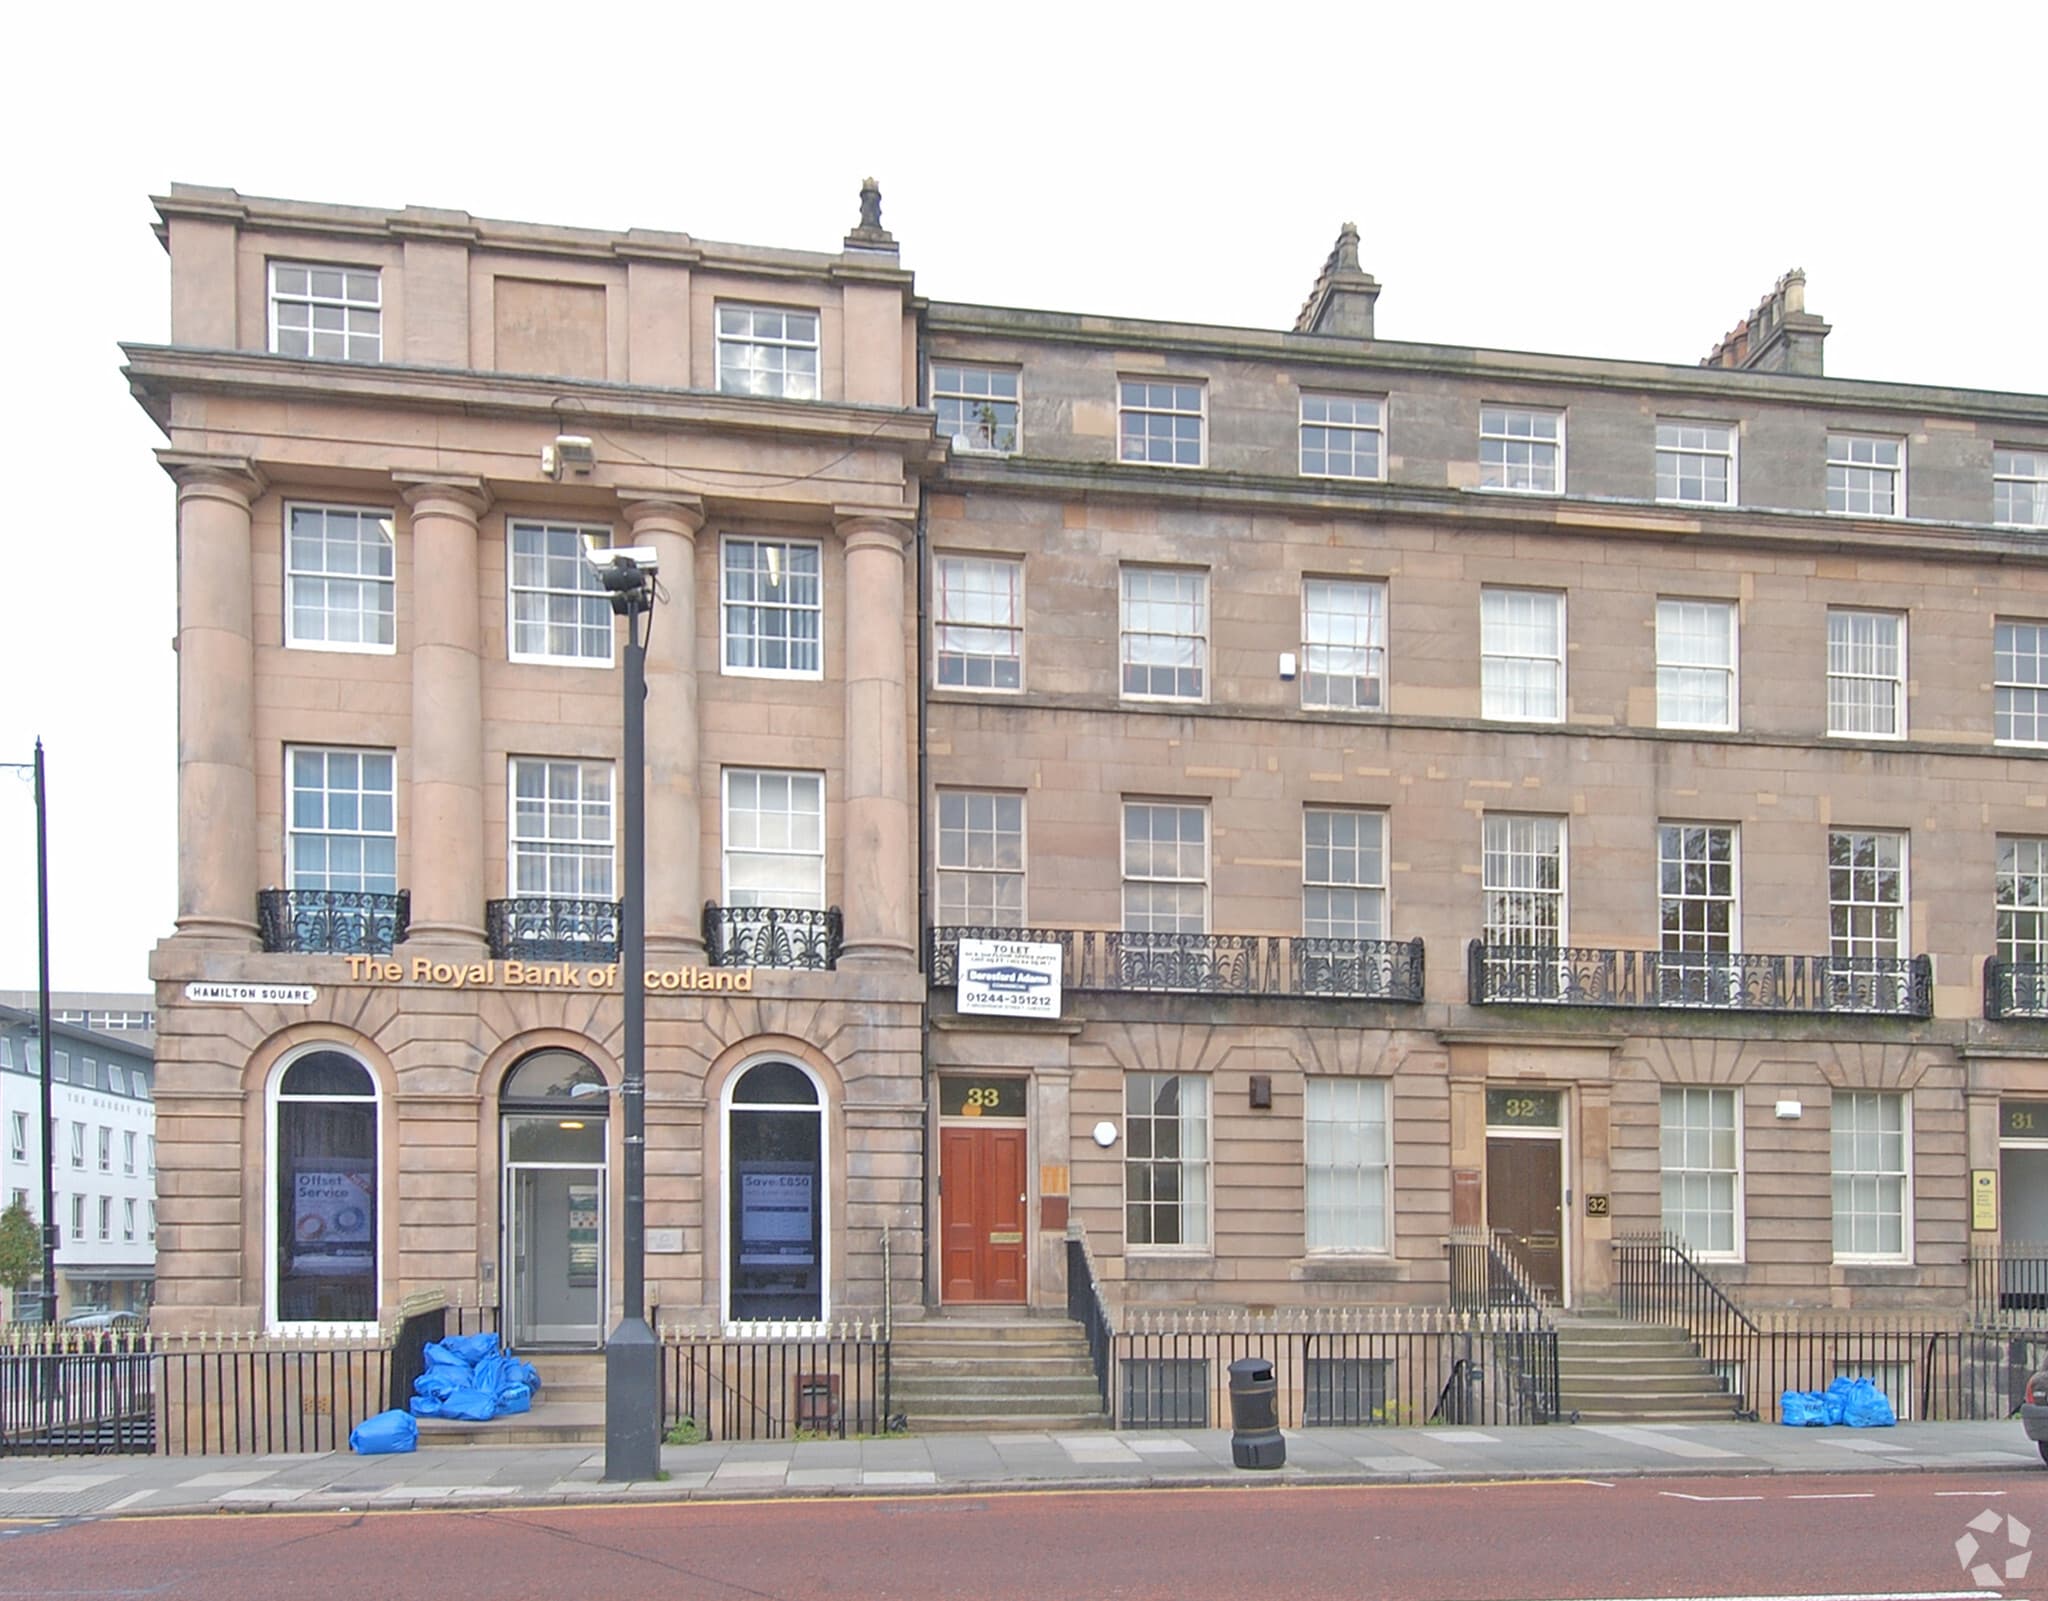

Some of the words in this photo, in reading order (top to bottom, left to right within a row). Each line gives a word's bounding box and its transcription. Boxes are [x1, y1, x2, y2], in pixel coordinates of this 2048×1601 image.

[993, 944, 1008, 954] TO
[1010, 945, 1030, 954] LET
[345, 955, 403, 982] The
[412, 956, 494, 988] Royal
[503, 960, 580, 986] Bank
[586, 963, 617, 987] of
[643, 965, 753, 991] cotland
[193, 986, 256, 998] HAMILTON
[261, 989, 310, 1000] SQUARE
[966, 992, 1051, 1006] 01244-351212
[967, 1087, 999, 1107] 33
[1506, 1099, 1536, 1118] 32
[2011, 1111, 2034, 1129] 31
[299, 1175, 342, 1186] Offset
[745, 1176, 777, 1187] Save
[298, 1187, 349, 1198] Service
[1589, 1198, 1606, 1212] 32
